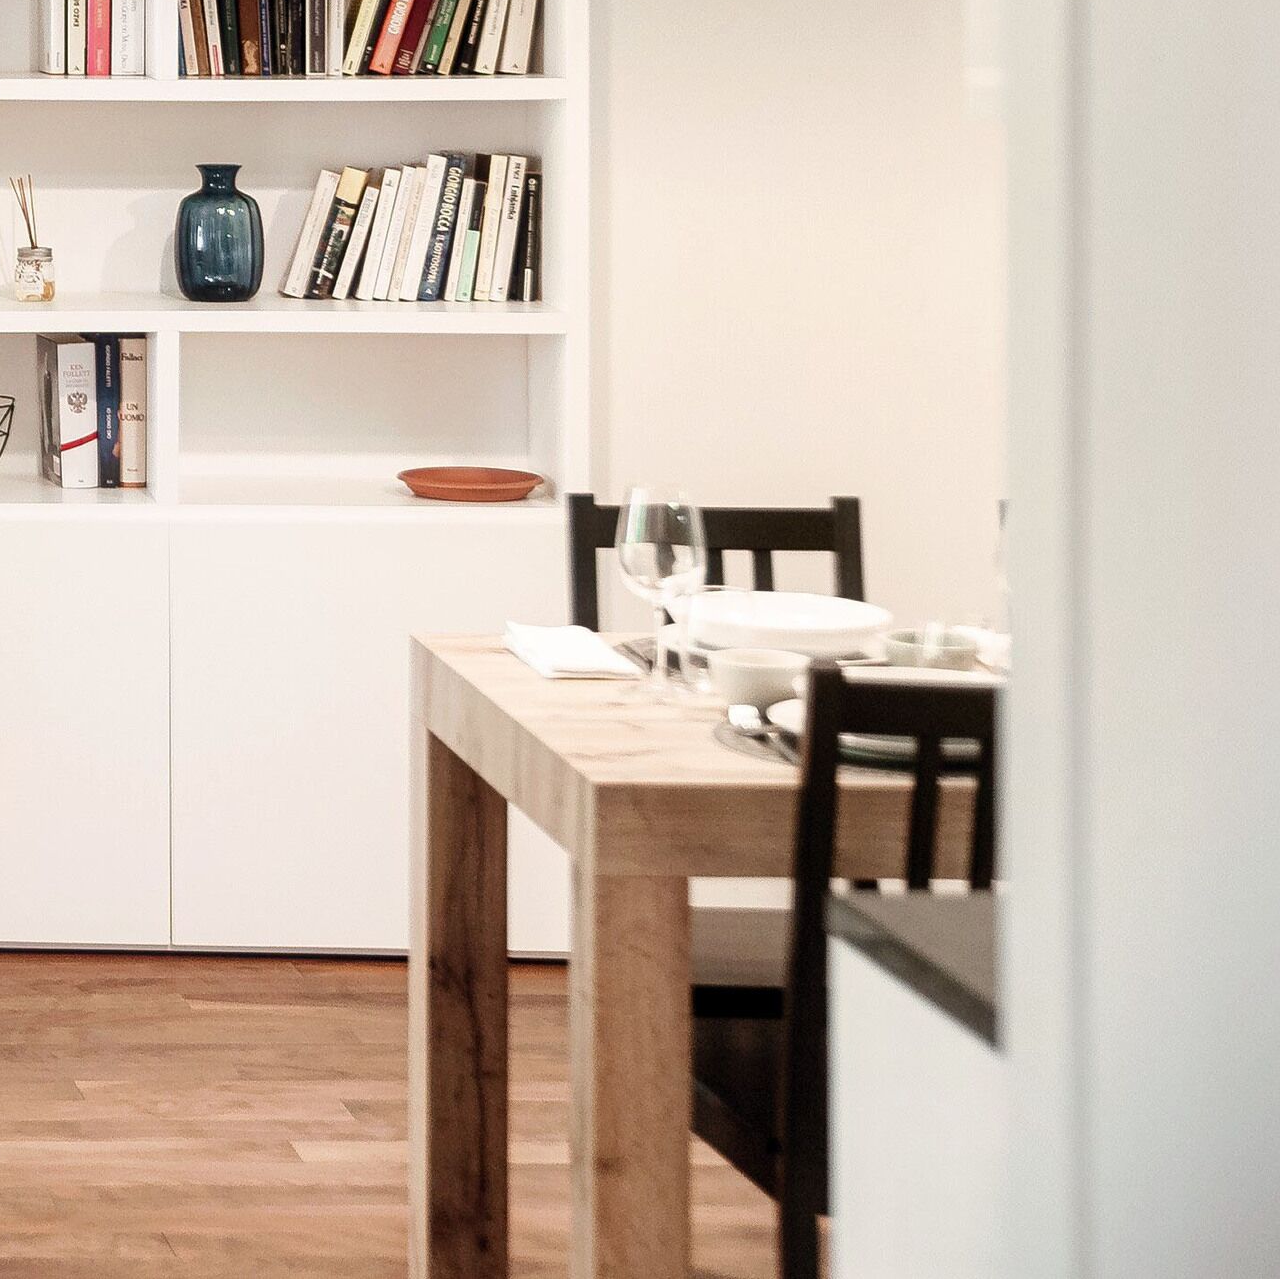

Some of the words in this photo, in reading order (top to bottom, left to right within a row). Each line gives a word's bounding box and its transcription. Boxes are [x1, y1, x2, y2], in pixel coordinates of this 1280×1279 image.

[443, 167, 462, 204] GIORGIO
[436, 201, 454, 232] BOCCA
[436, 233, 444, 242] IL
[427, 241, 443, 284] SOTTOSOPRA
[121, 352, 143, 362] Fallaci
[62, 370, 90, 378] FOLLETT
[105, 406, 111, 414] IO
[126, 403, 138, 411] UN
[120, 413, 145, 422] UOMO
